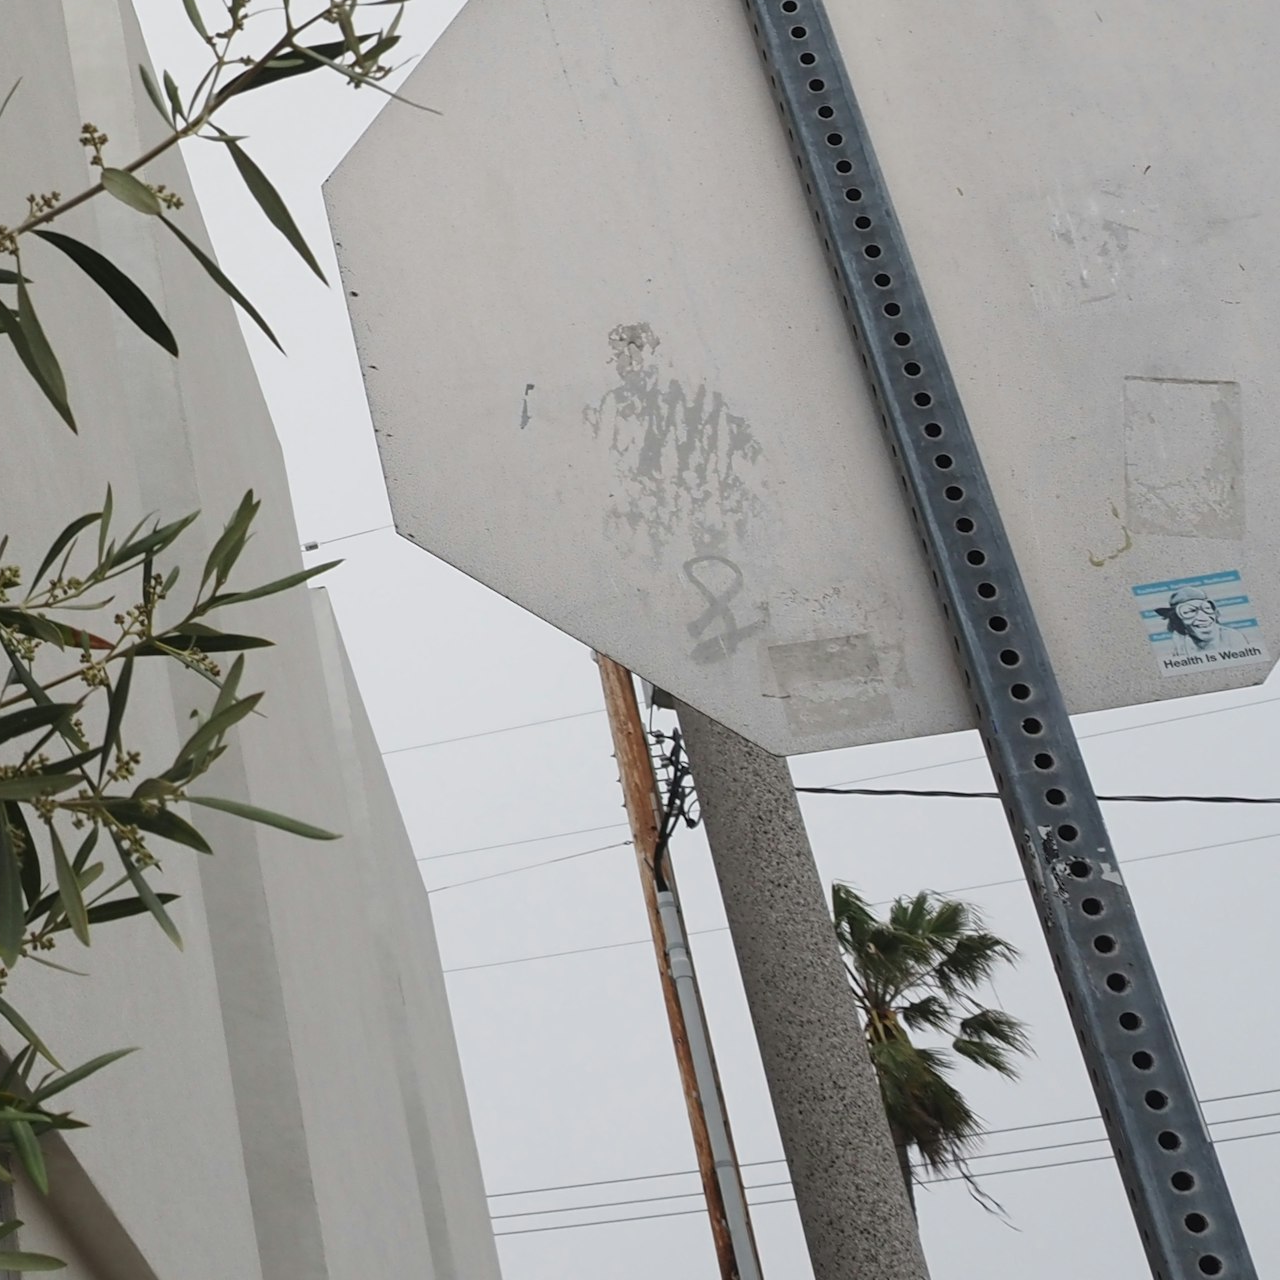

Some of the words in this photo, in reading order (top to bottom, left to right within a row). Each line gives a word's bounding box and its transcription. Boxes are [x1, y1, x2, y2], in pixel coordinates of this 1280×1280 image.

[1163, 655, 1203, 669] Health
[1206, 654, 1217, 663] Is
[1219, 647, 1262, 661] Wealth
